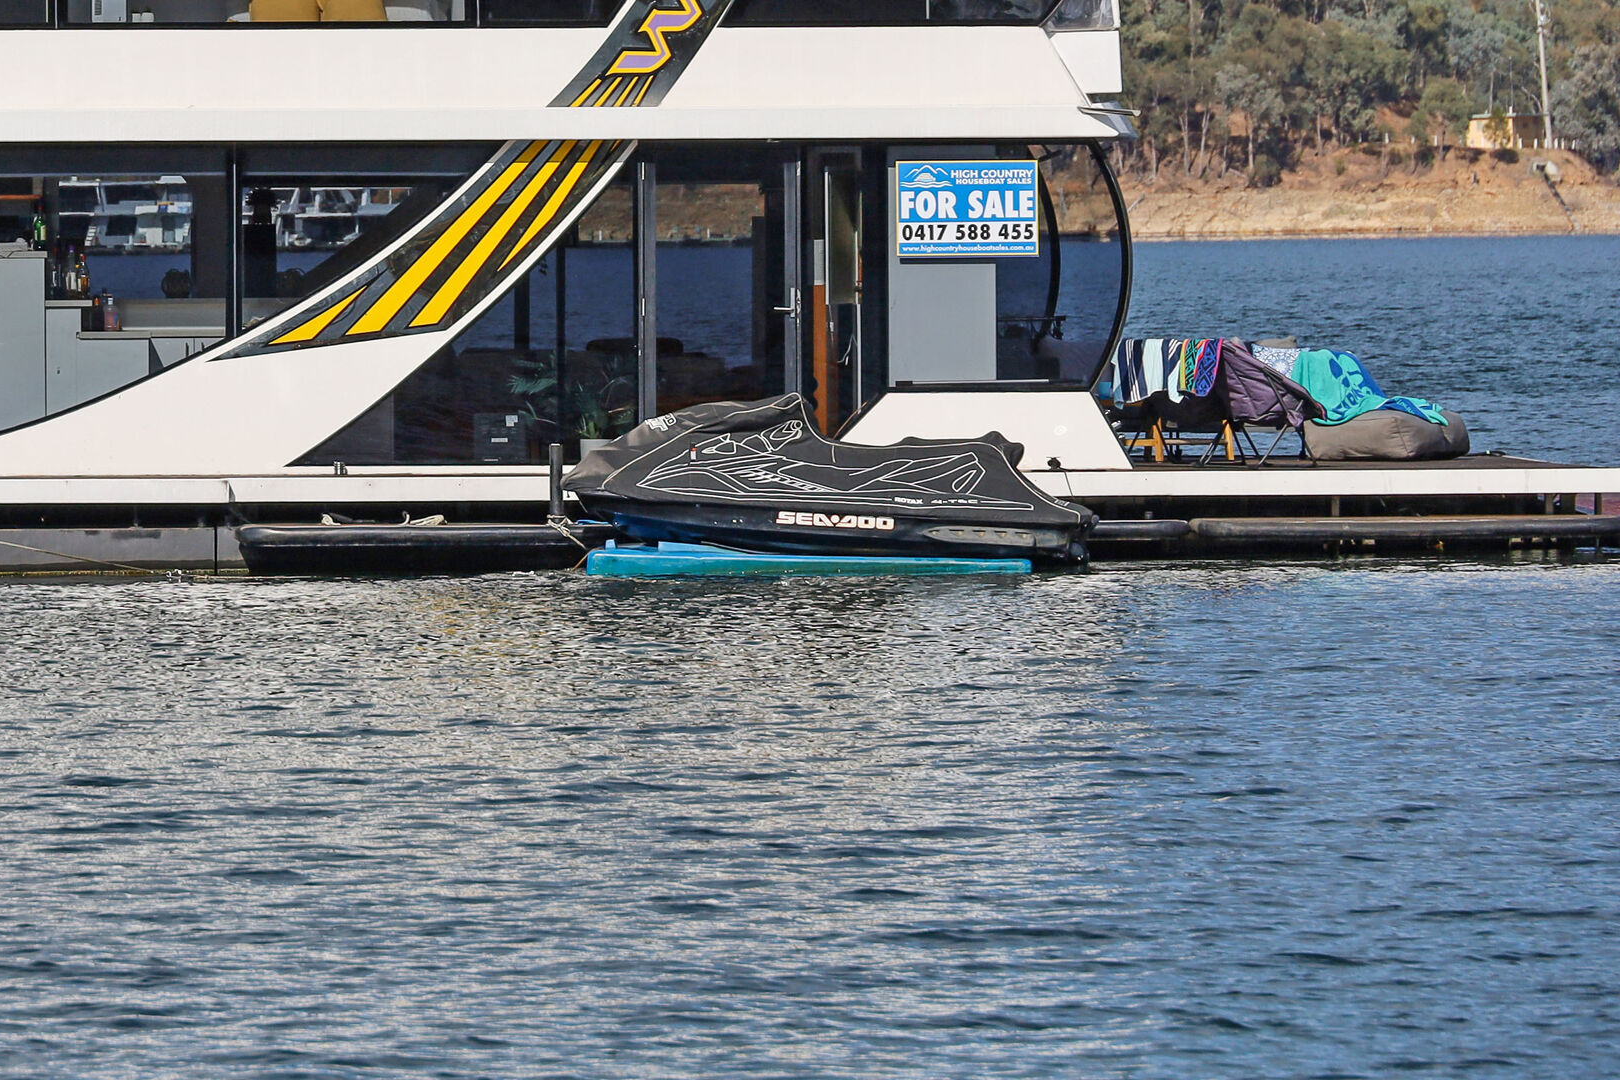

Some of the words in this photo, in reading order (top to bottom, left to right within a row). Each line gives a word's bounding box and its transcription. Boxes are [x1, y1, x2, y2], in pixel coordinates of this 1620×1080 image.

[950, 169, 978, 178] HIGH
[980, 169, 1034, 178] COUNTRY
[900, 190, 958, 219] FOR
[967, 190, 1035, 219] SALE
[902, 224, 947, 241] 0417
[955, 224, 991, 240] 588
[998, 223, 1034, 240] 455
[902, 244, 1034, 253] www.highcountryhouseboatsales.com.au
